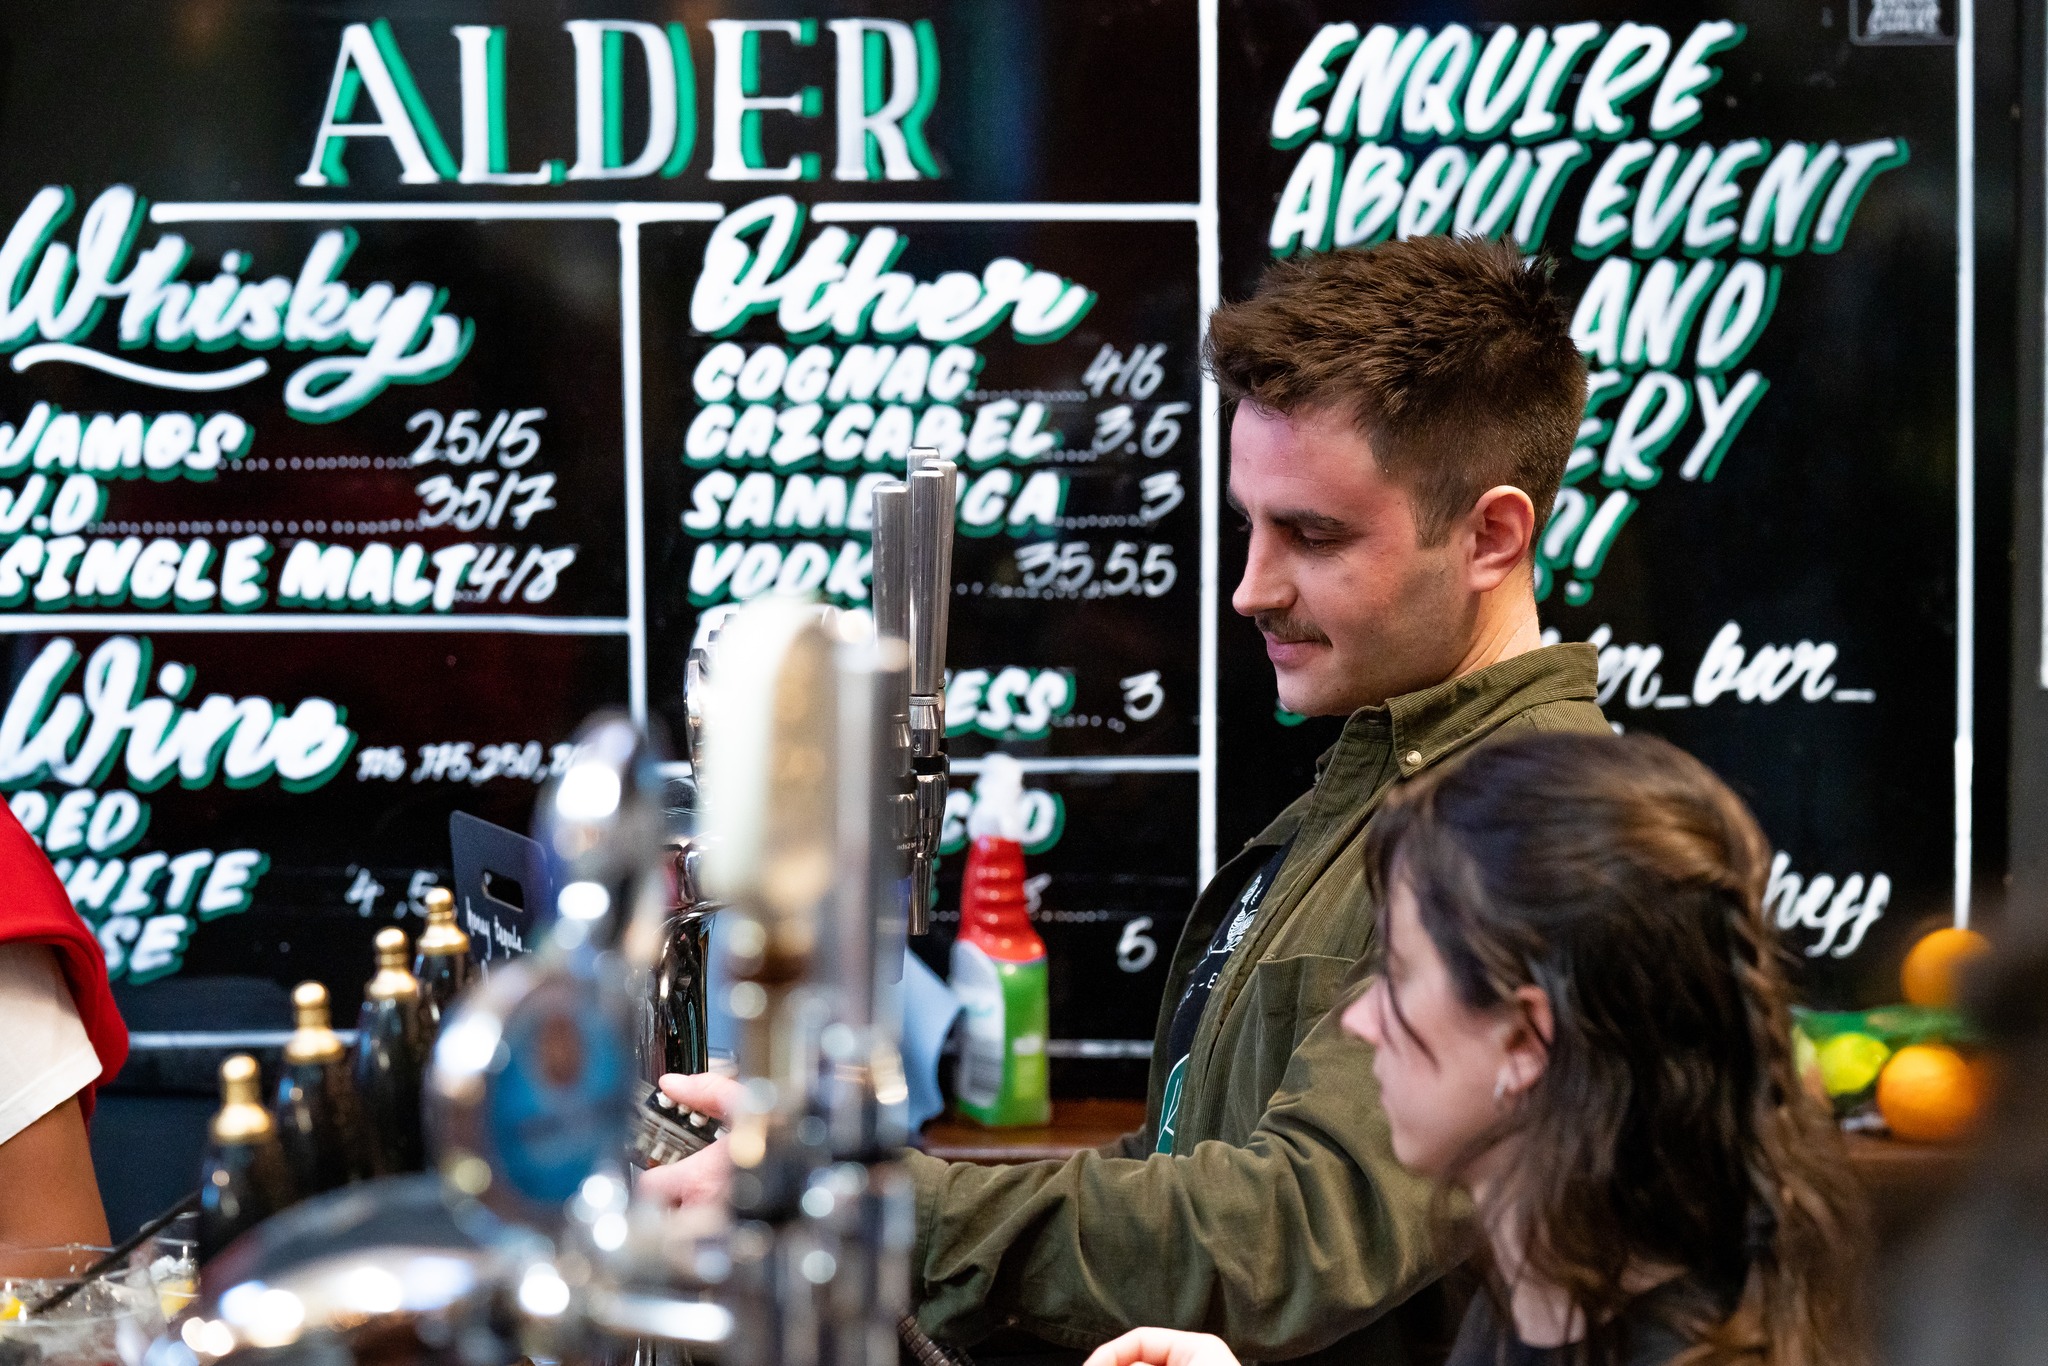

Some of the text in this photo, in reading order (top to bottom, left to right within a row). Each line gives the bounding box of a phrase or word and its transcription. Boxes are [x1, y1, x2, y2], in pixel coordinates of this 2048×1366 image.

[296, 18, 941, 186] ALDER
[1270, 20, 1747, 150] ENQUIRE
[1268, 136, 1910, 260] ABOUT EVENT
[0, 184, 476, 424] Whisky
[690, 195, 1098, 345] Other
[692, 342, 986, 410] COGNAC
[0, 535, 272, 614] SINGLE
[278, 540, 478, 614] MALT
[688, 540, 873, 608] VODK
